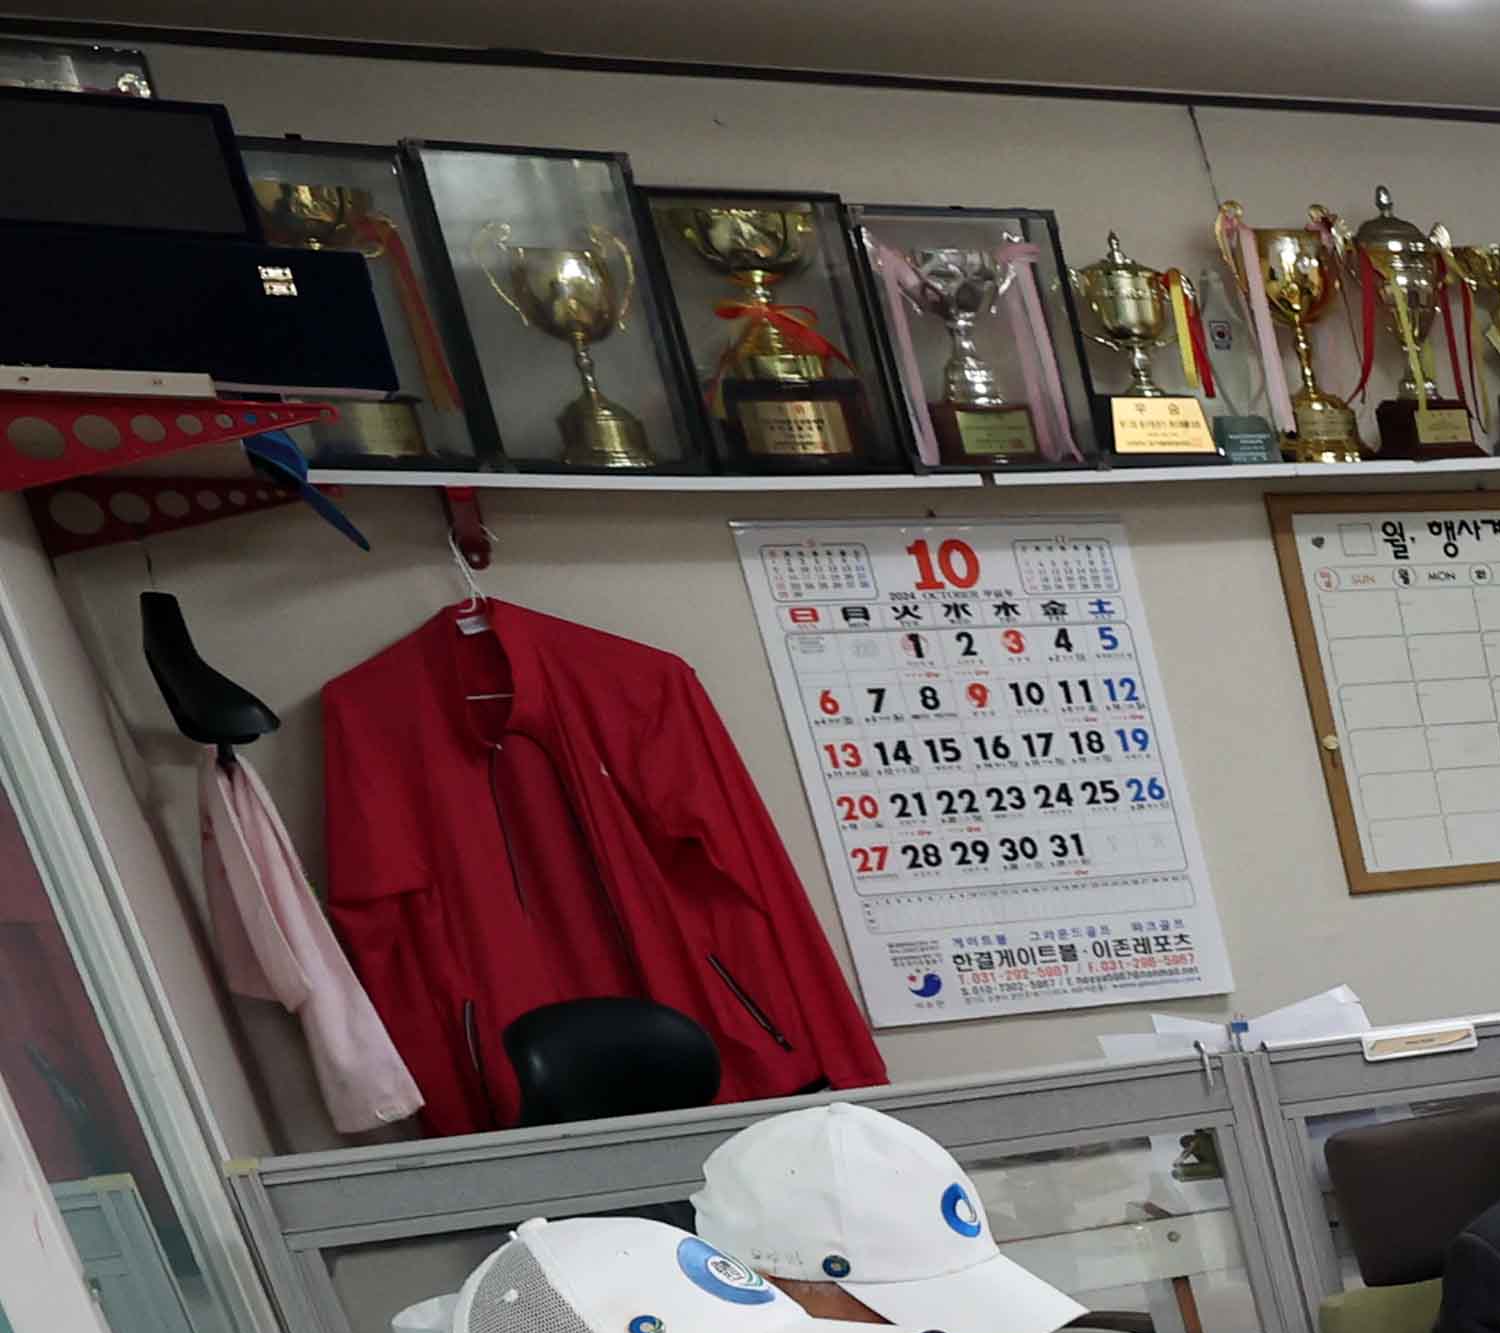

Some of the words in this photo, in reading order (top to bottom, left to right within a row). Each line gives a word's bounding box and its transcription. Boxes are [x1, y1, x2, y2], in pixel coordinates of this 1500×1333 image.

[906, 538, 980, 590] 10
[1351, 573, 1375, 586] SUN
[1428, 571, 1456, 583] MON
[789, 607, 819, 624] 日
[841, 606, 870, 621] 月
[891, 604, 922, 620] 火
[941, 602, 973, 618] 水
[992, 601, 1021, 617] 木
[1041, 600, 1068, 616] 金
[1088, 599, 1115, 615] 土
[889, 592, 916, 600] 2024
[907, 634, 924, 658] 1
[956, 632, 977, 656] 2
[1004, 630, 1024, 654] 3
[1055, 628, 1072, 652] 4
[1099, 627, 1118, 650] 5
[820, 691, 839, 715] 6
[868, 688, 885, 713] 7
[920, 686, 940, 710] 8
[968, 683, 988, 708] 9
[1009, 682, 1044, 706] 10
[1059, 680, 1092, 704] 11
[1104, 678, 1138, 701] 12
[824, 743, 861, 768] 13
[874, 740, 911, 765] 14
[925, 738, 961, 763] 15
[974, 736, 1010, 760] 16
[1022, 733, 1053, 757] 17
[1070, 731, 1104, 754] 18
[1116, 728, 1148, 752] 19
[837, 796, 878, 820] 20
[890, 792, 927, 817] 21
[937, 789, 979, 814] 22
[986, 787, 1025, 811] 23
[1034, 783, 1073, 808] 24
[1081, 780, 1119, 804] 25
[1126, 778, 1164, 801] 26
[851, 846, 888, 872] 27
[902, 844, 942, 868] 28
[951, 840, 989, 865] 29
[1000, 837, 1037, 861] 30
[1050, 834, 1083, 857] 31
